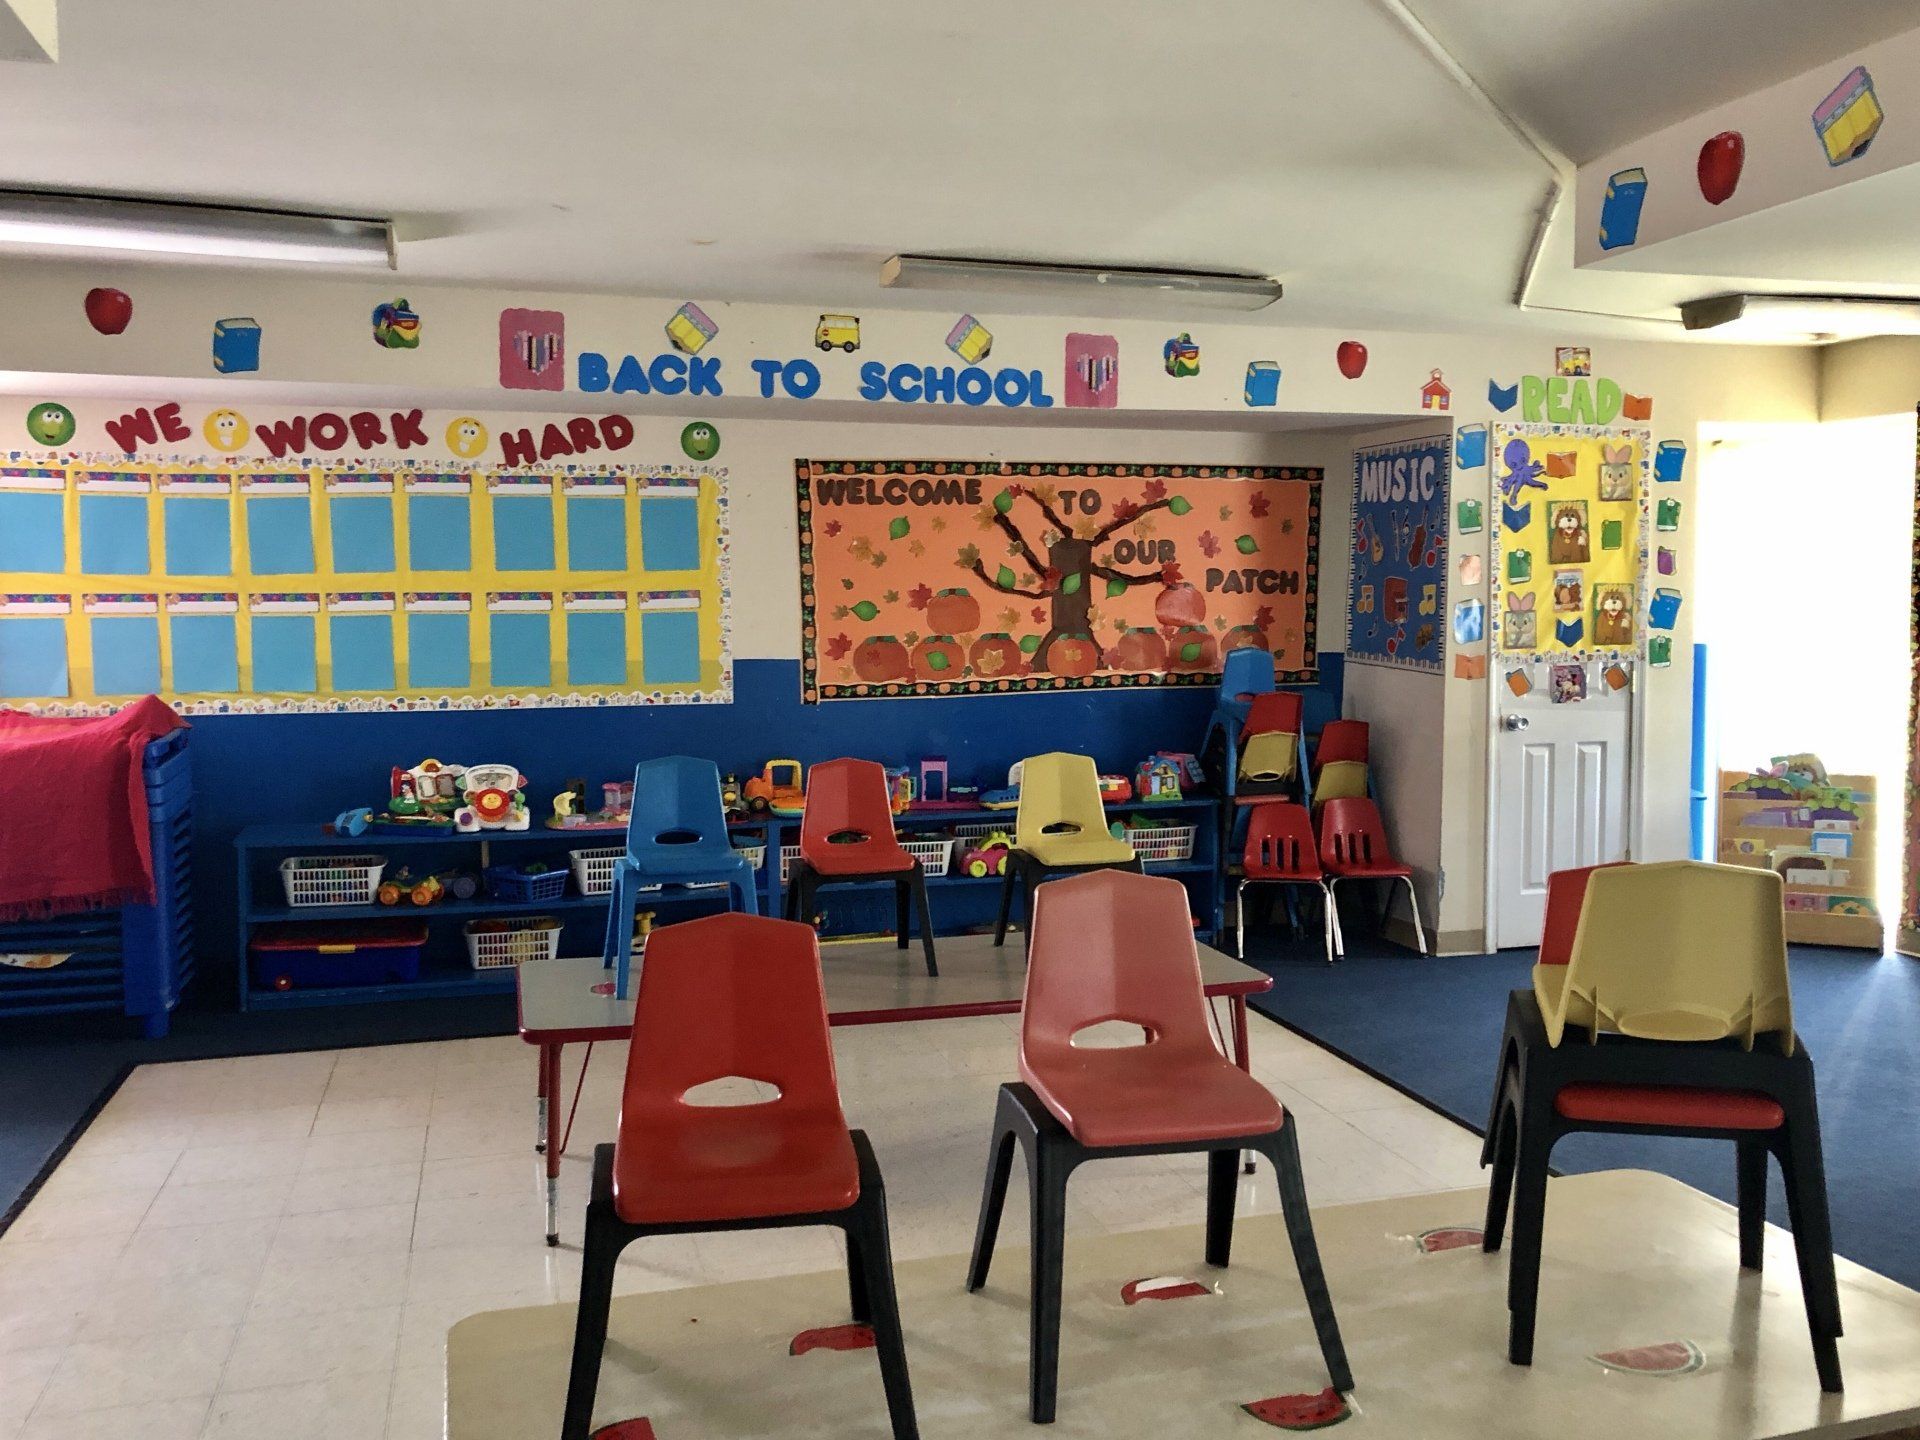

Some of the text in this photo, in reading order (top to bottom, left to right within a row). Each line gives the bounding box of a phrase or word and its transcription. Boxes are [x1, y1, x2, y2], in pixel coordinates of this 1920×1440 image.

[578, 352, 1054, 408] BACK TO SCHOOL
[1521, 375, 1622, 425] READ
[105, 402, 635, 467] WE WORK HARD
[816, 477, 1101, 515] WELCOME TO
[1360, 455, 1436, 503] MUSIC
[1114, 538, 1176, 565] OUR
[1205, 568, 1299, 596] PATCH
